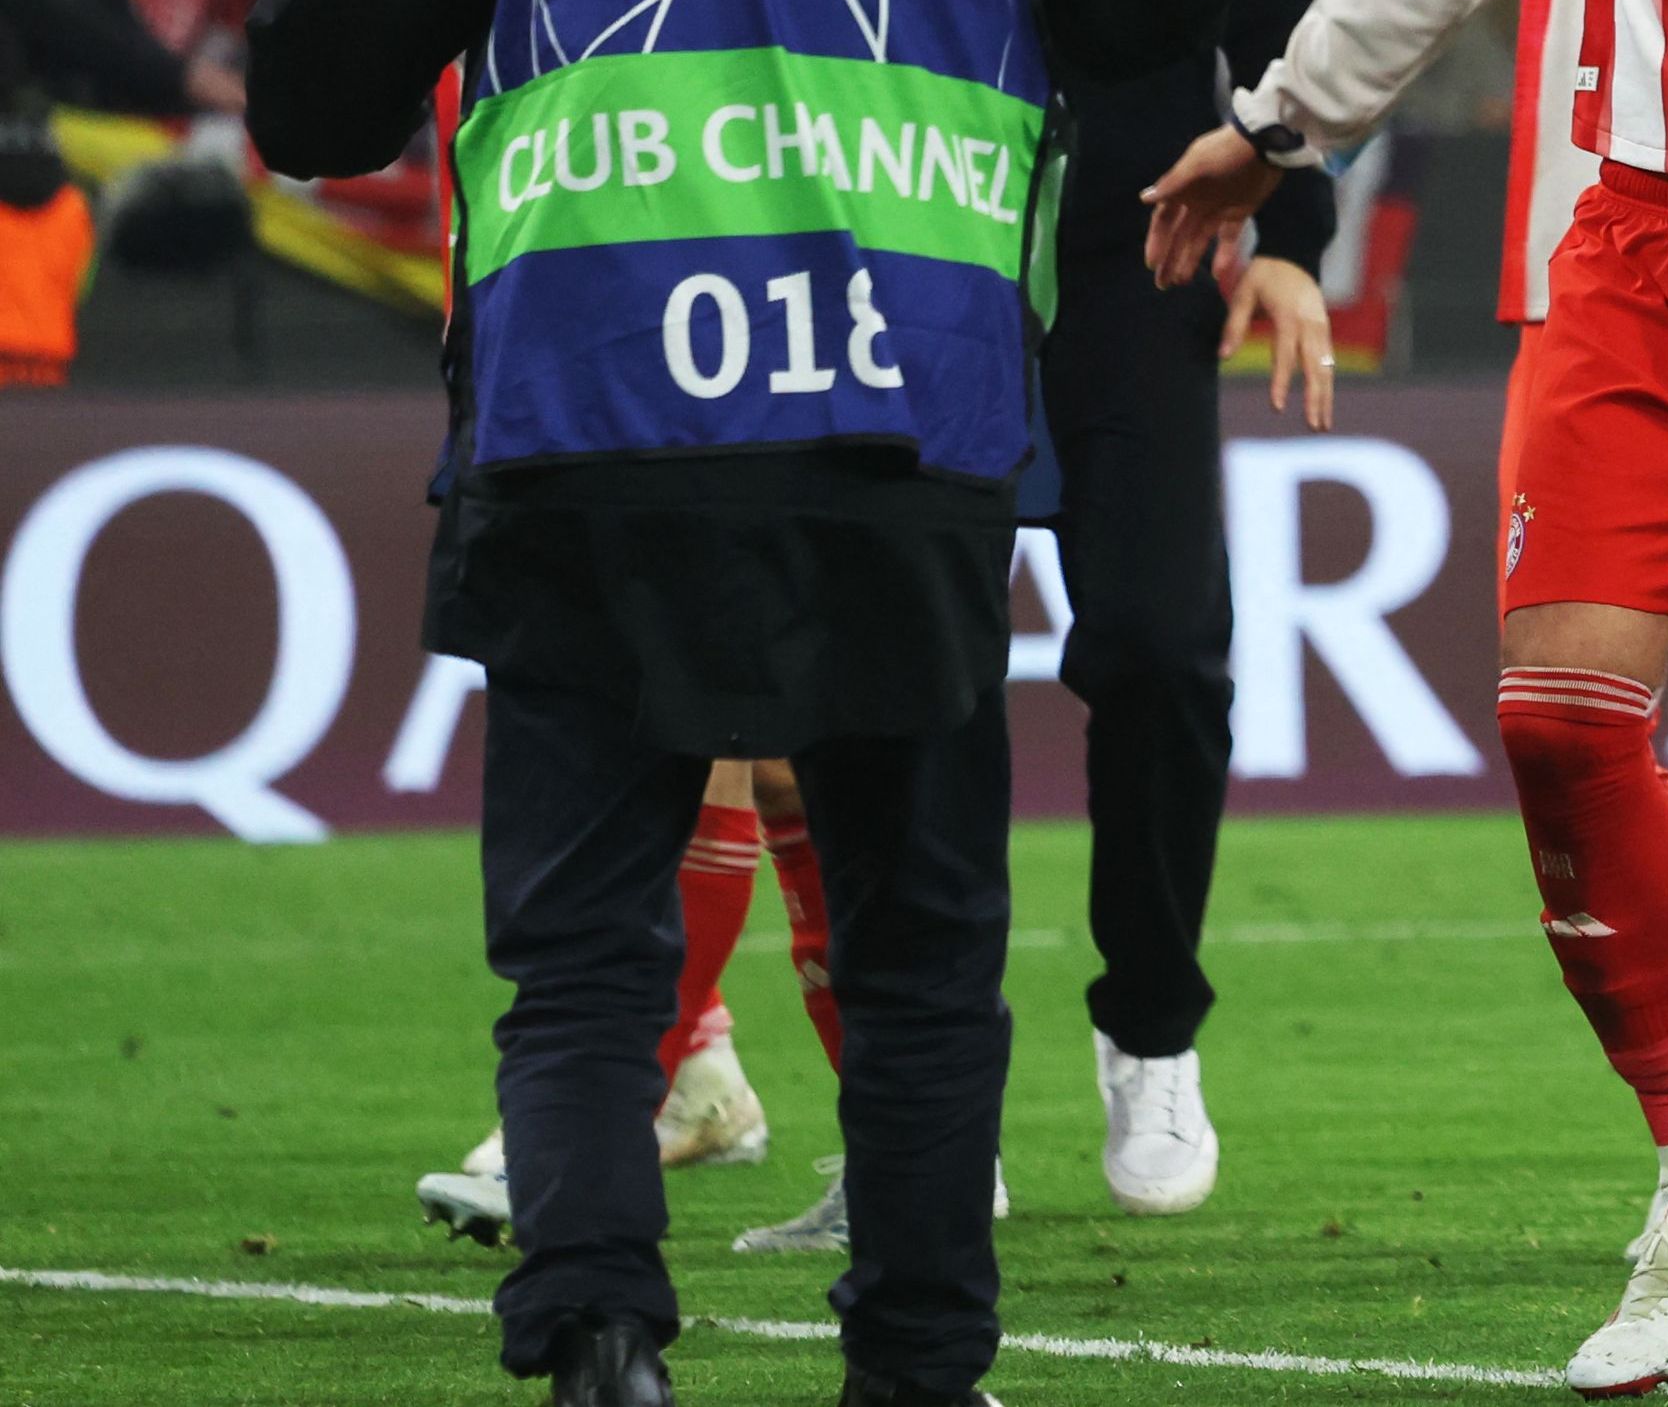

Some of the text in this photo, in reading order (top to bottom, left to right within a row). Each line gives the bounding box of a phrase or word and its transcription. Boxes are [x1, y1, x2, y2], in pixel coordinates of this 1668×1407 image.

[499, 102, 1017, 224] CLUB CHANNEL
[662, 269, 904, 399] 018
